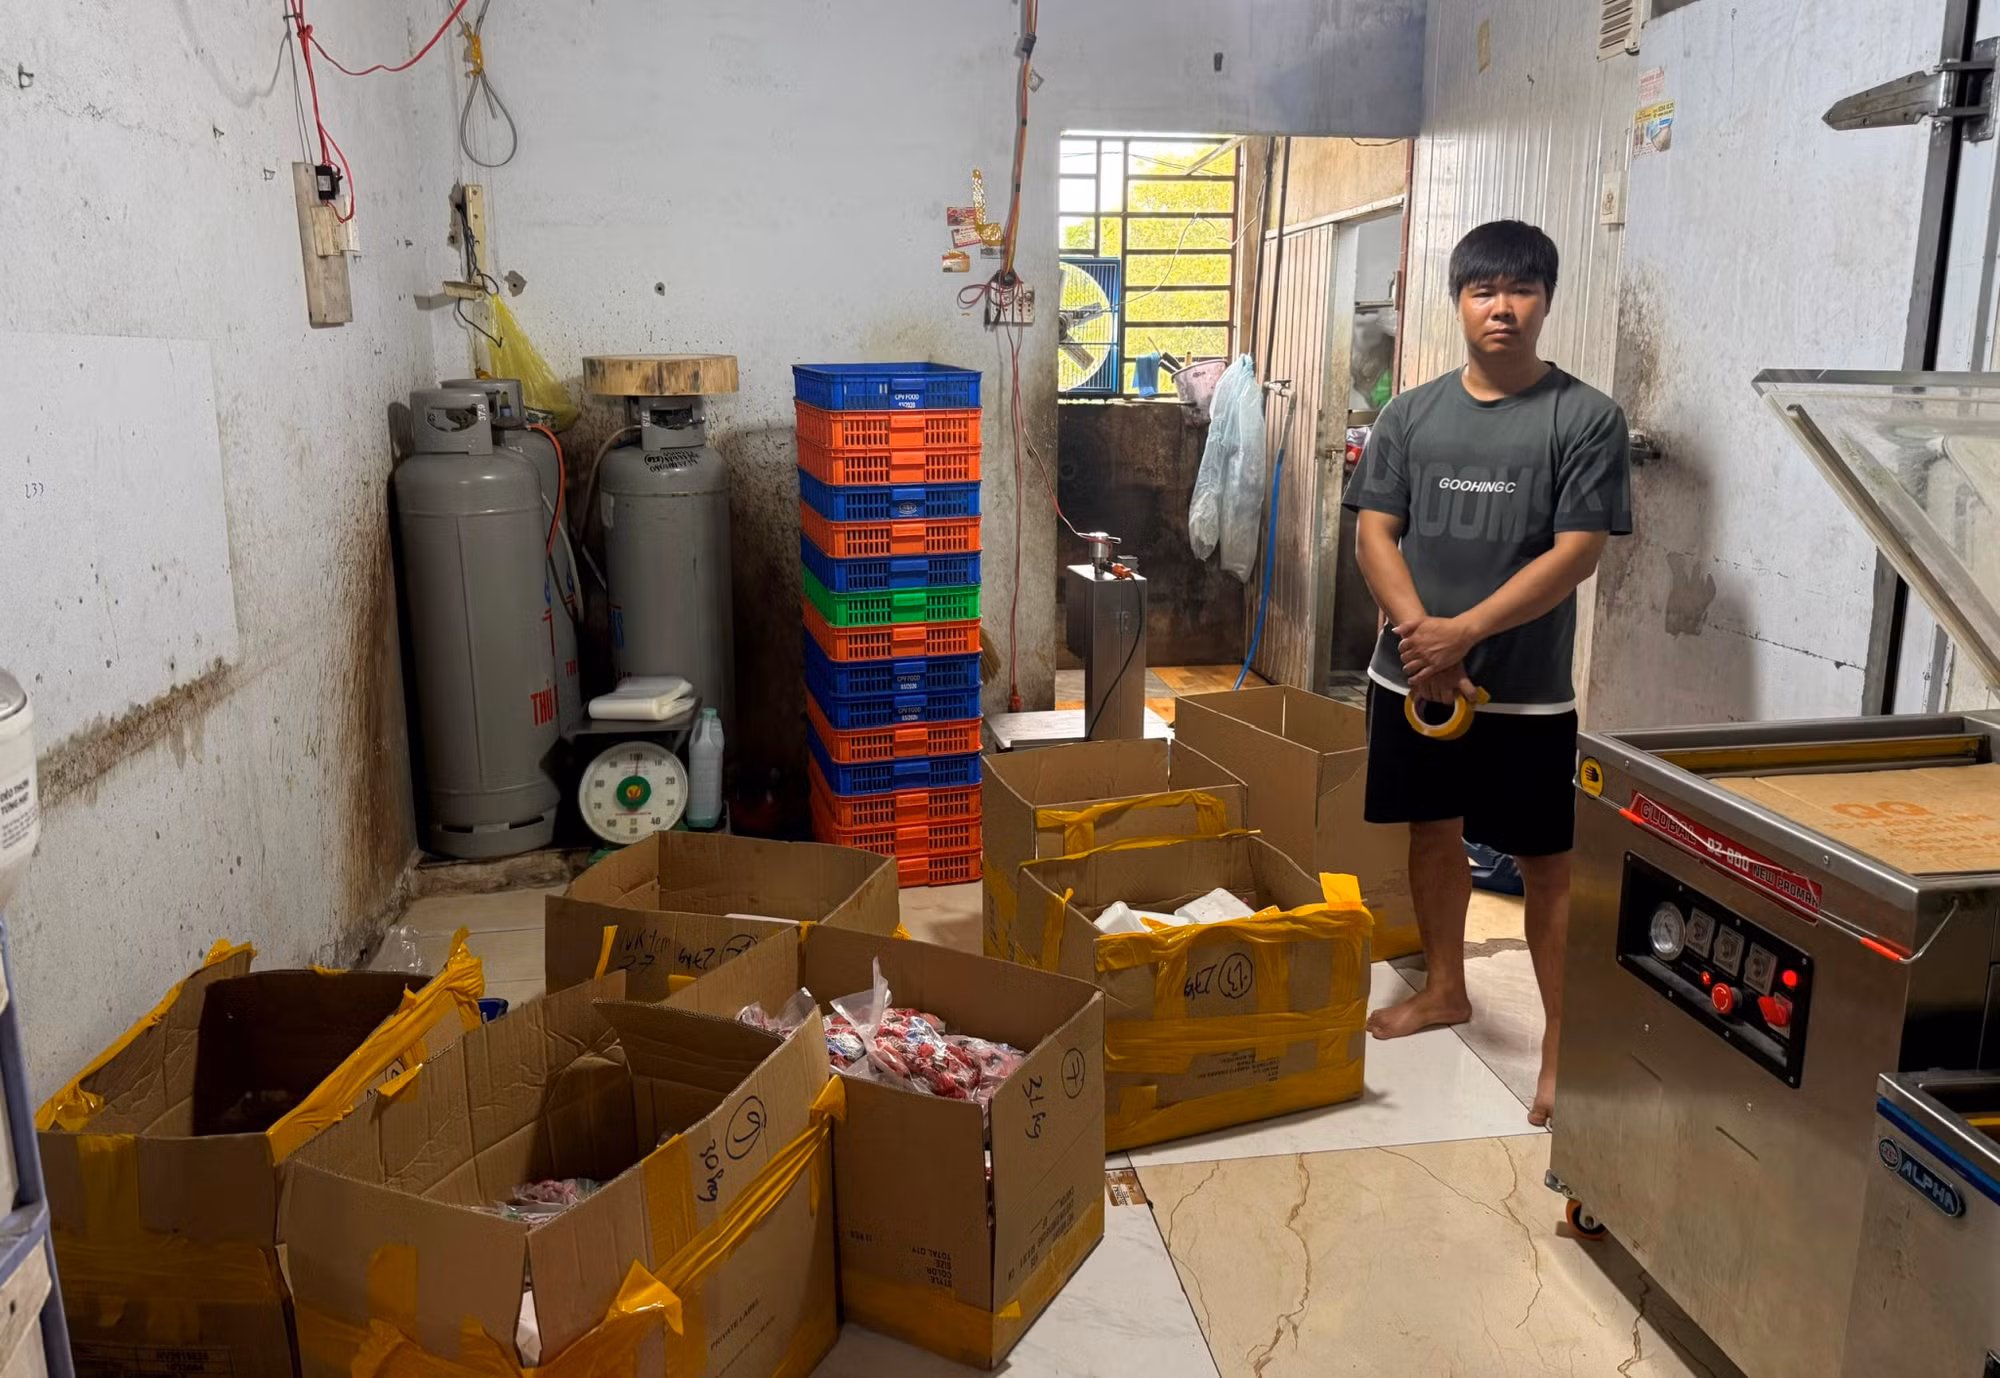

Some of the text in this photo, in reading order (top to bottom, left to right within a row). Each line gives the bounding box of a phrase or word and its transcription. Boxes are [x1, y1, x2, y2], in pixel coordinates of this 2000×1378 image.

[1438, 476, 1517, 494] GOOHINGC
[665, 776, 676, 785] 20
[651, 816, 661, 826] 40
[1640, 801, 1698, 846] GLOBAL
[1752, 864, 1776, 886] NEW
[1901, 1160, 1955, 1212] ALPHA
